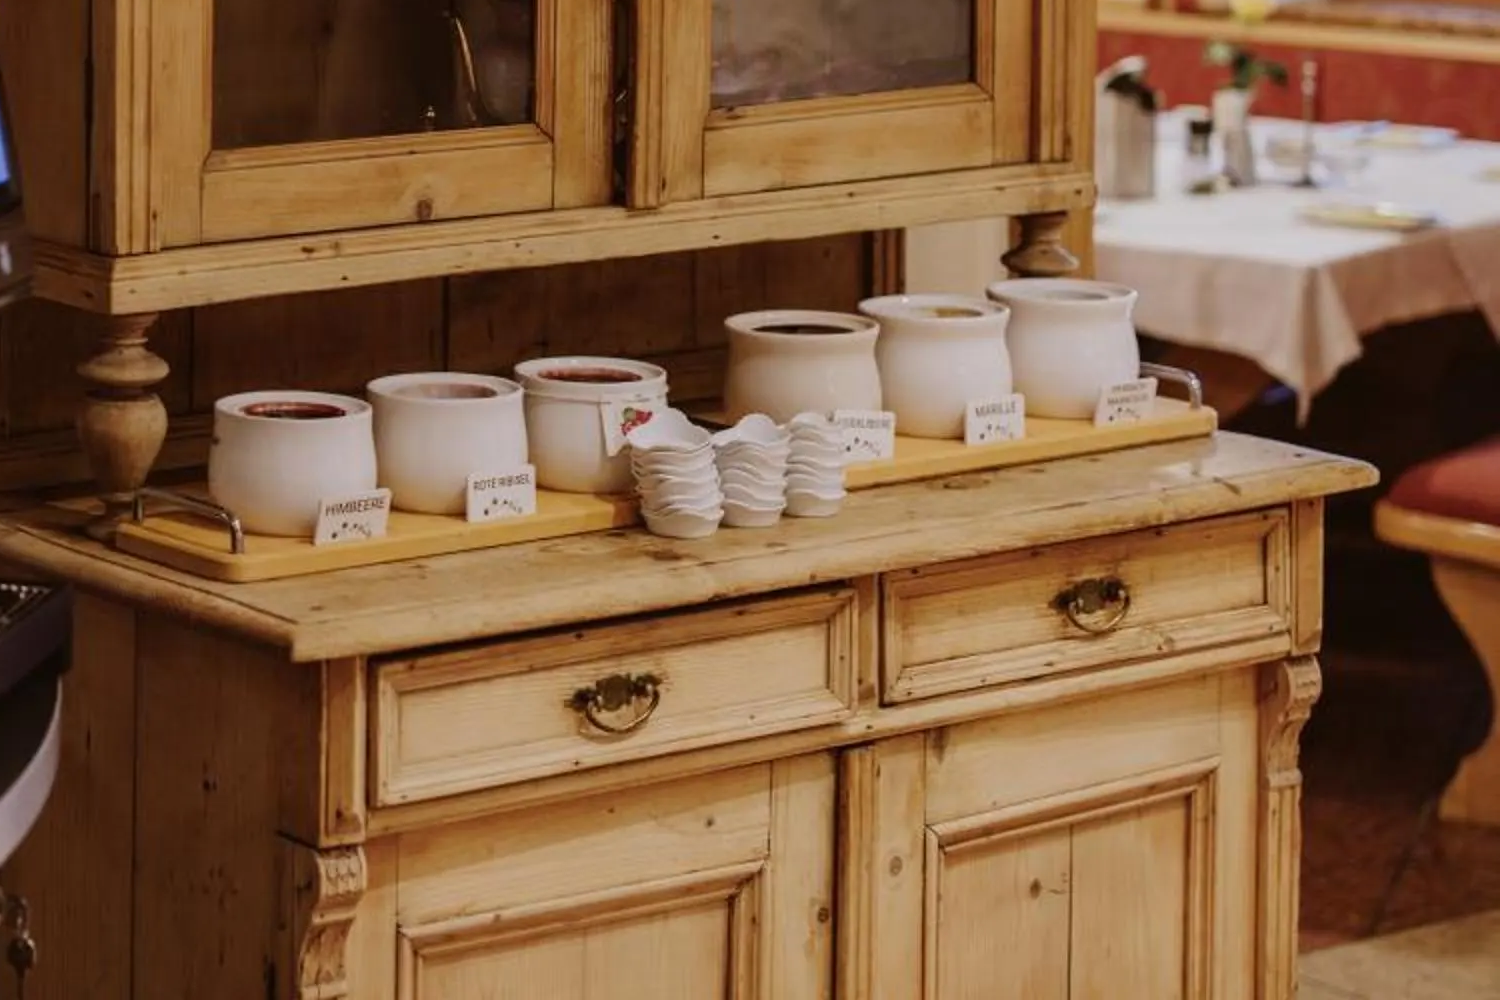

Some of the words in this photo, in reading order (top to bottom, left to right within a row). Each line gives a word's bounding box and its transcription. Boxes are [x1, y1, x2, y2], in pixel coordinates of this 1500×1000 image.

[975, 400, 1016, 418] MARILLE
[473, 479, 497, 492] ROTE
[325, 497, 385, 517] HIMBEERE
